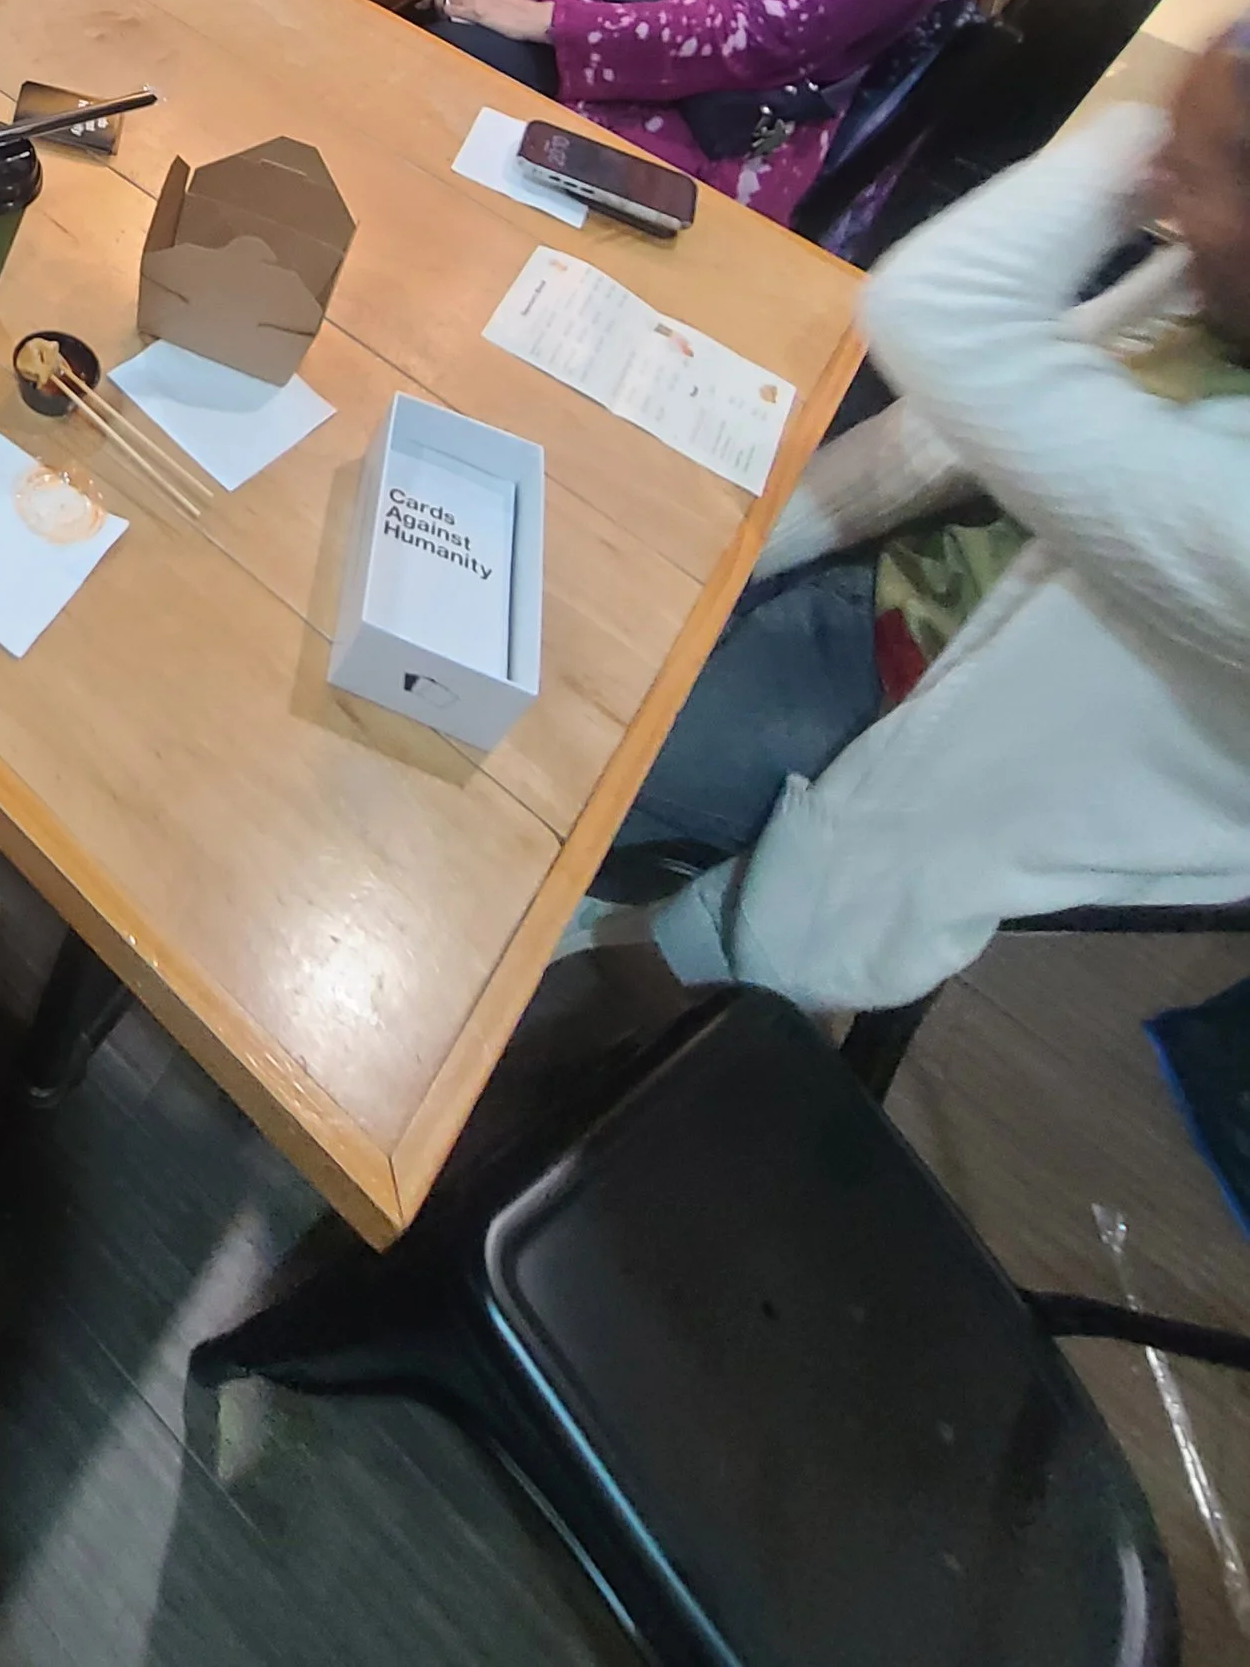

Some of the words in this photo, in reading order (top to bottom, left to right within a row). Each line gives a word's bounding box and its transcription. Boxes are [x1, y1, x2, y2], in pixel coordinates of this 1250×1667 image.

[385, 504, 472, 551] Against
[388, 487, 455, 526] Cards
[383, 521, 493, 580] Humanity
